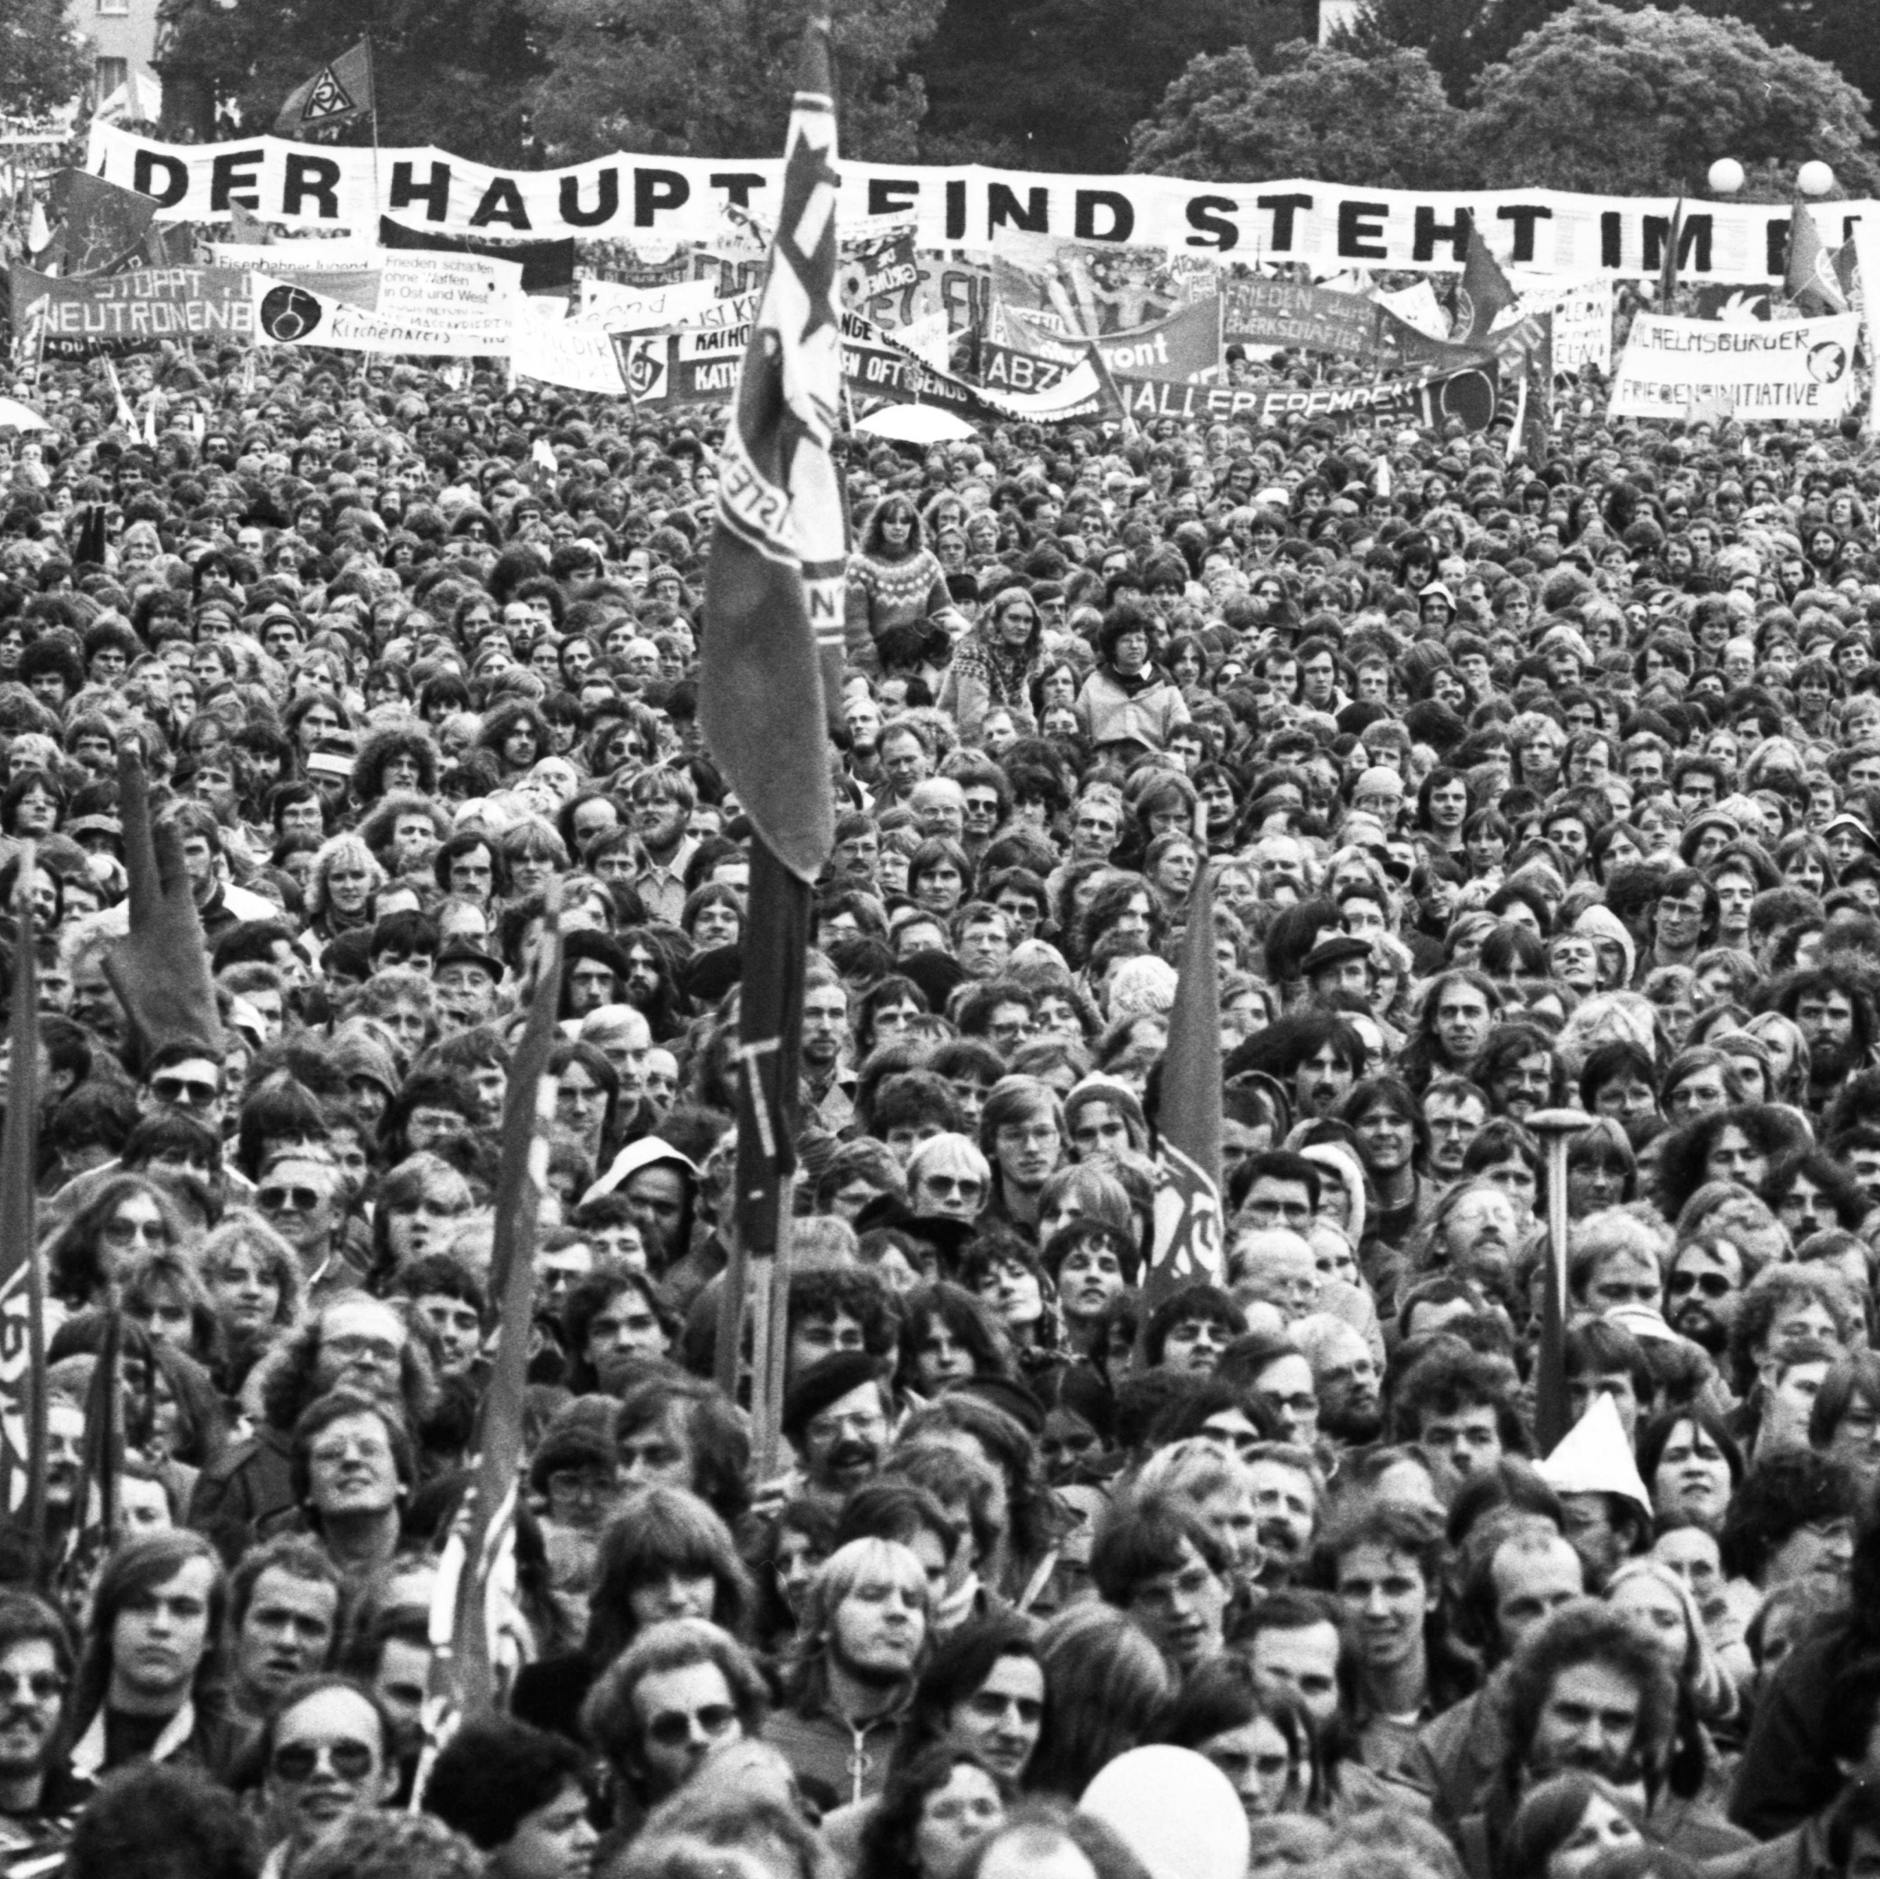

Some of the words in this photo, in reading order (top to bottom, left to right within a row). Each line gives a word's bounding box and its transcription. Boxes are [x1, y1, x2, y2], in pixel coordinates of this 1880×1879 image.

[134, 149, 341, 218] DER
[390, 161, 1135, 242] HAUPTEIND
[1185, 193, 1552, 261] STEHT
[1601, 212, 1713, 272] IM
[384, 271, 419, 282] ohne
[385, 255, 437, 269] Frieden
[442, 261, 494, 275] schaffen
[94, 268, 206, 299] STOPPT
[384, 287, 395, 297] in
[400, 286, 423, 299] Ost
[427, 289, 454, 300] und
[458, 290, 489, 304] West
[1225, 285, 1312, 311] FRIEDEN
[46, 300, 253, 334] NEUTRONENB
[700, 304, 725, 326] IST
[1632, 322, 1810, 352] WILHELMSBURGER
[866, 356, 902, 386] OFT
